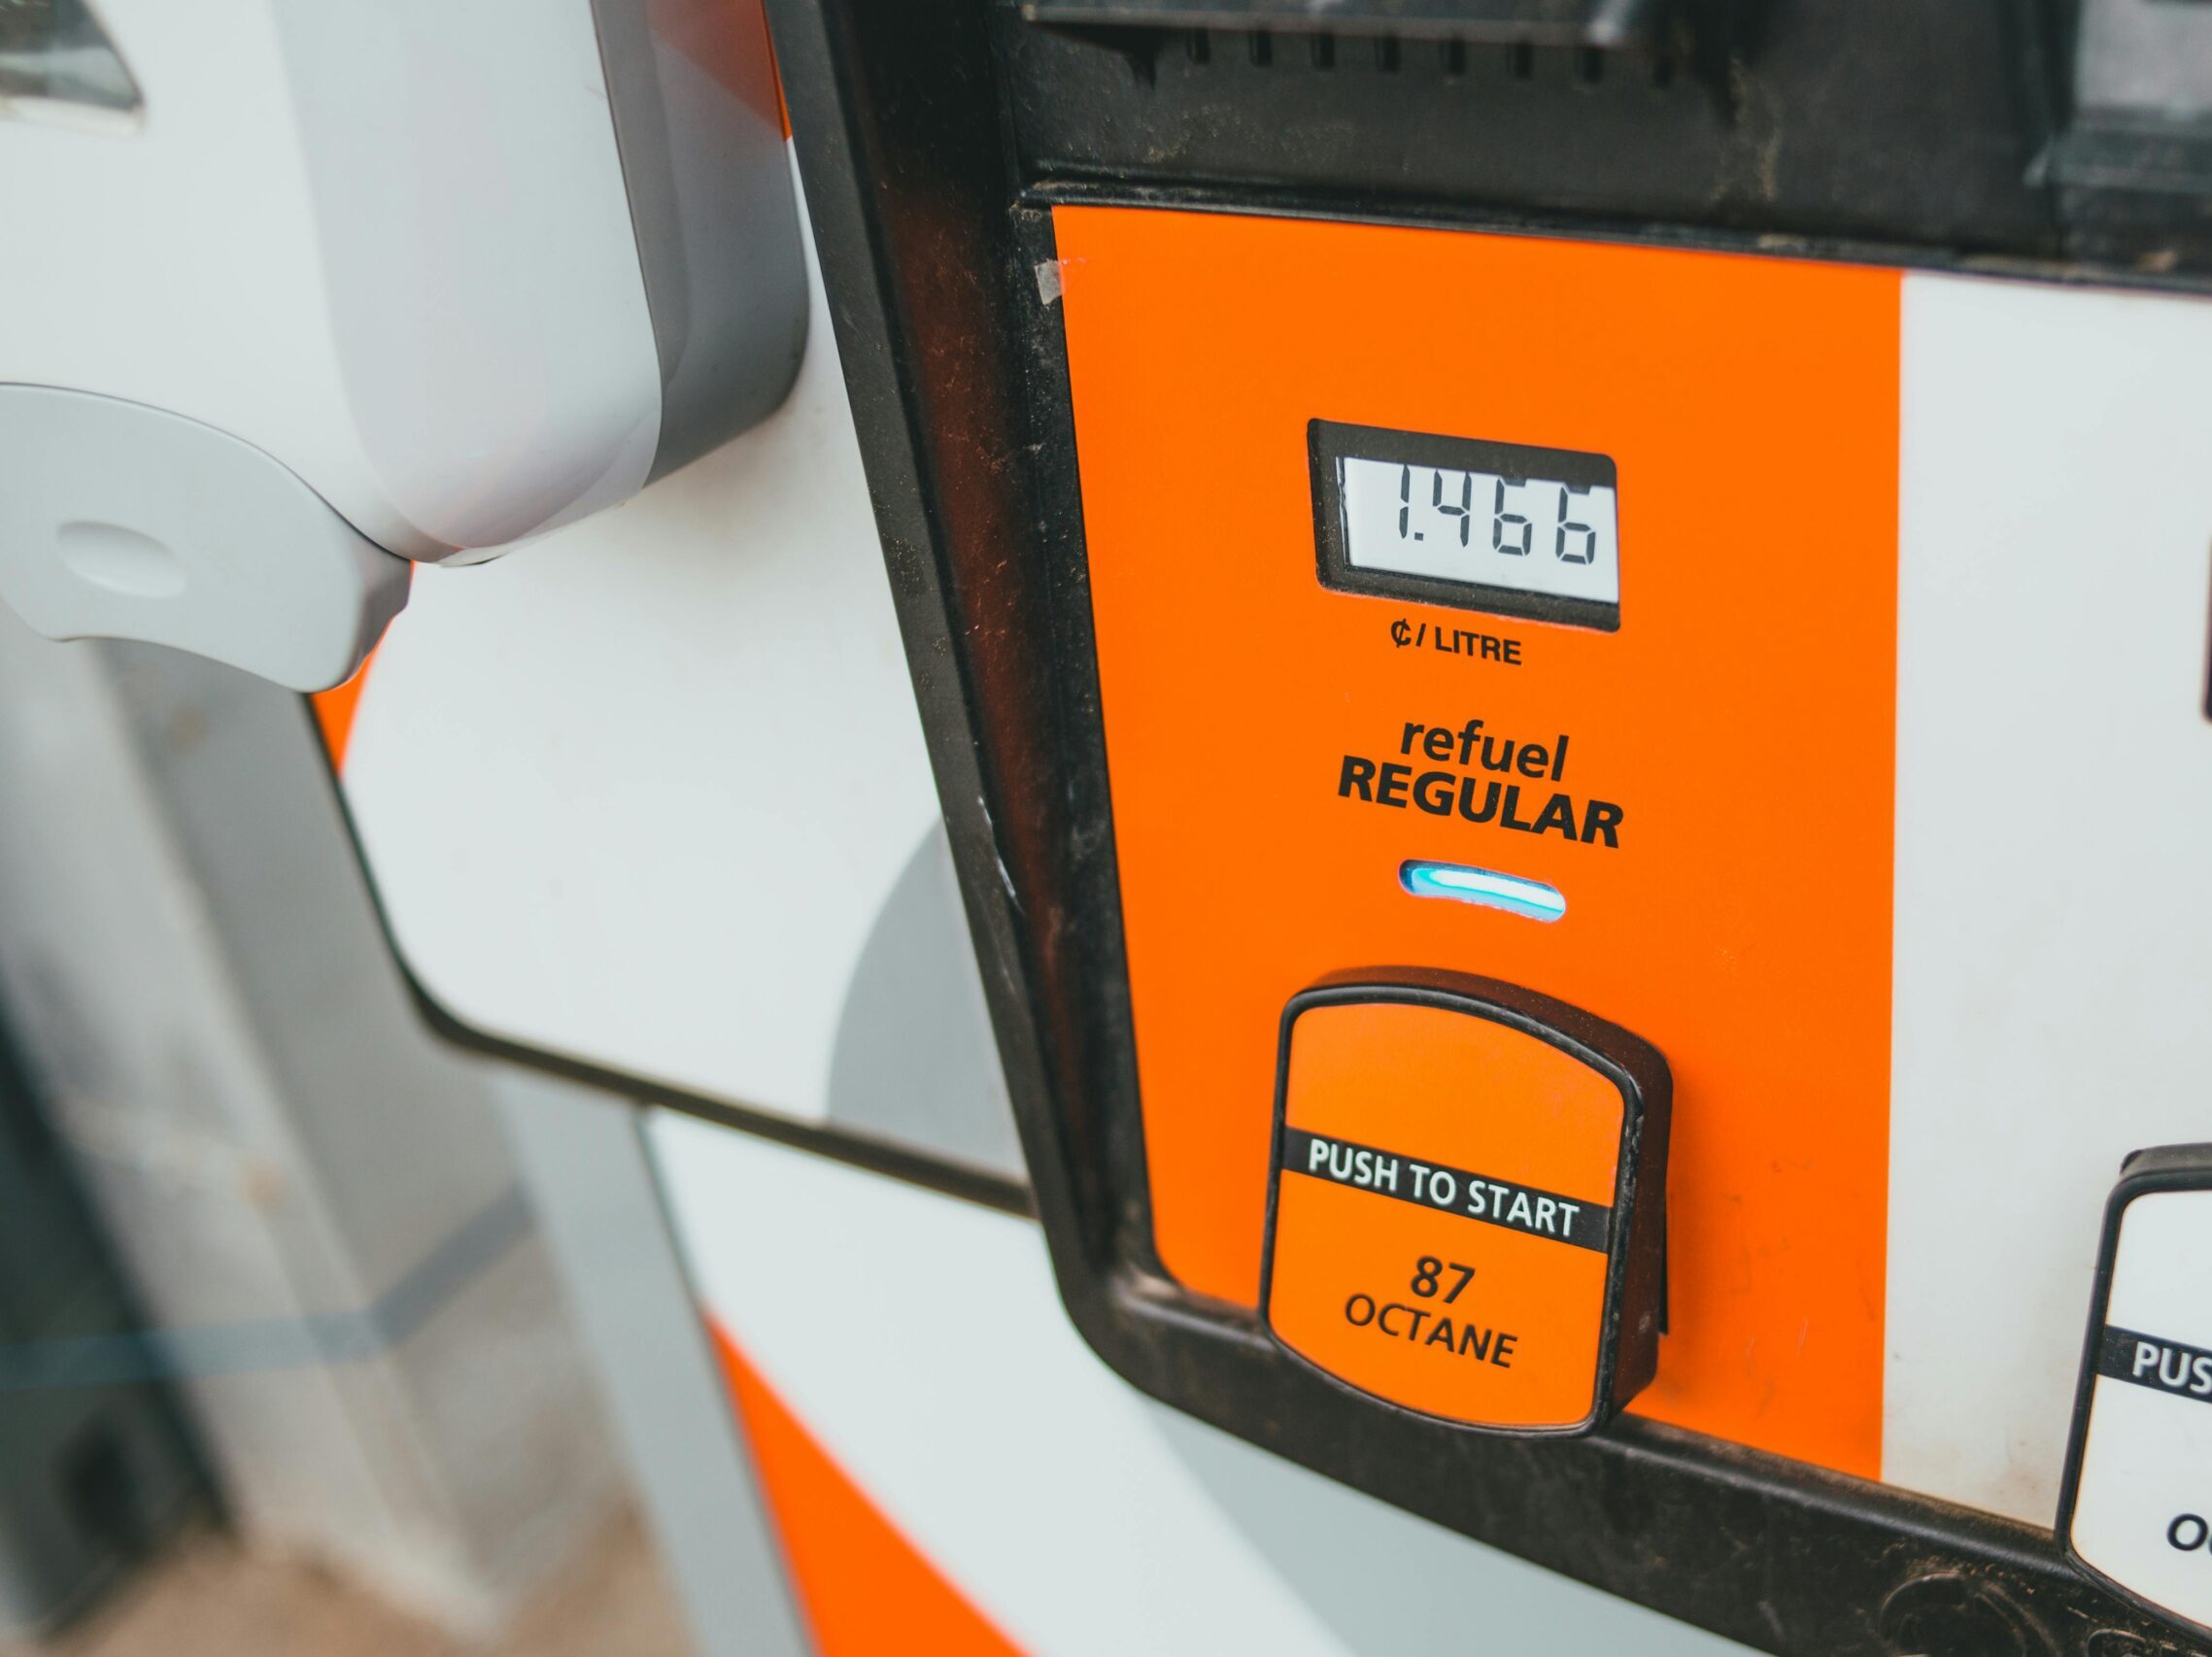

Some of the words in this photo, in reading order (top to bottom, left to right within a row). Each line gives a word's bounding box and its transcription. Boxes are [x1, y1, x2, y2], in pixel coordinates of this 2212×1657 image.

[1399, 464, 1596, 564] 1.466
[1434, 626, 1522, 665] LITRE
[1400, 719, 1569, 782] refuel
[1337, 755, 1624, 849] REGULAR
[1308, 1138, 1398, 1193] PUSH
[1410, 1164, 1456, 1206] TO
[1467, 1180, 1580, 1237] START
[1411, 1256, 1476, 1304] 87
[1344, 1294, 1518, 1369] OCTANE
